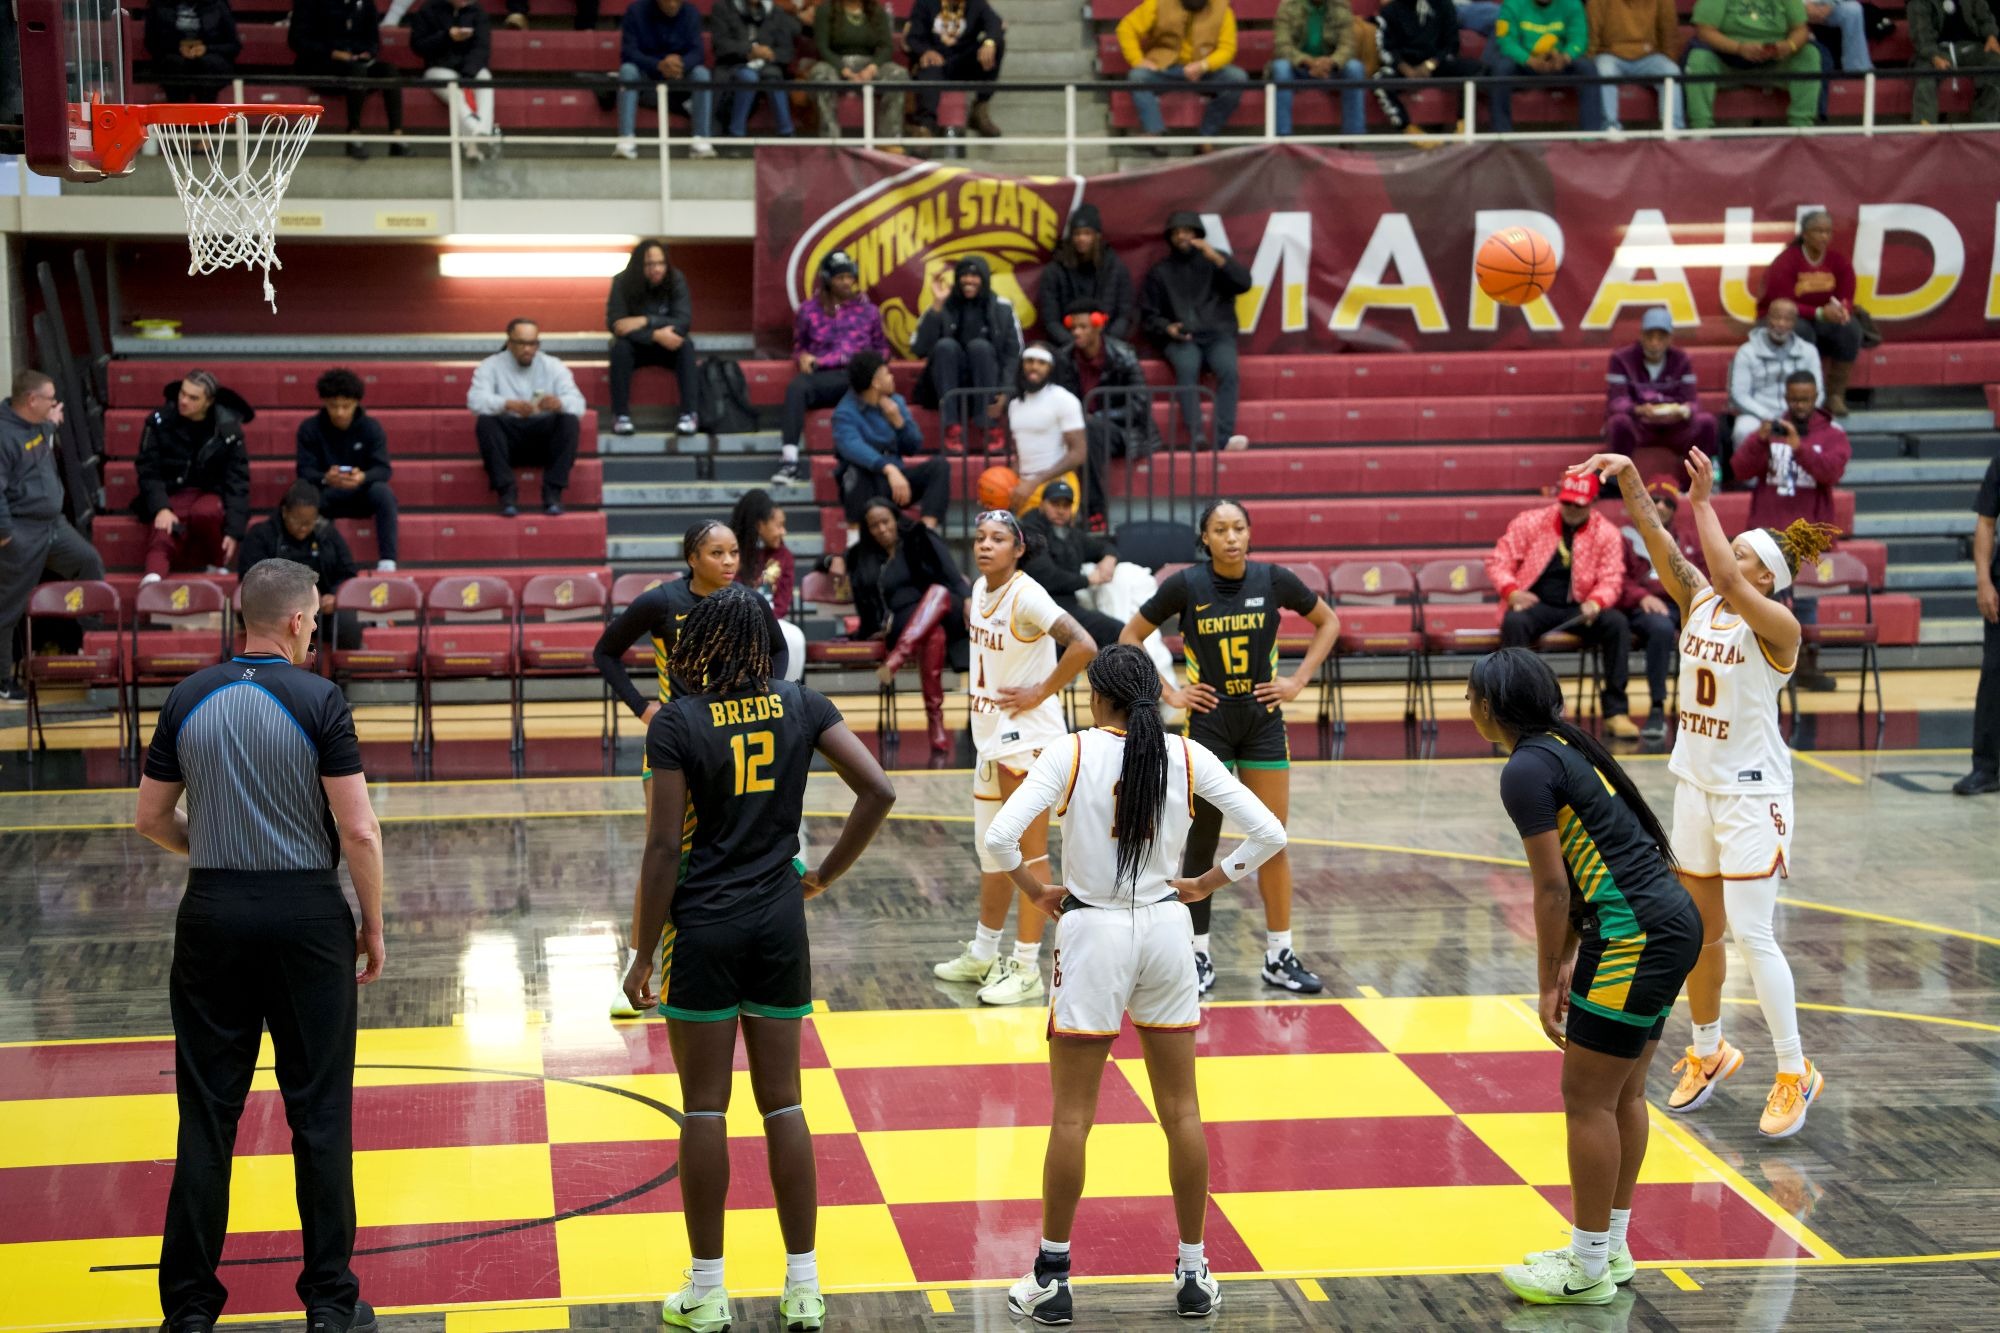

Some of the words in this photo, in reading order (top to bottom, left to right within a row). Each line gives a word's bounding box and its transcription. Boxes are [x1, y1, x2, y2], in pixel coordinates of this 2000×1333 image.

[958, 177, 1059, 252] STATE
[1200, 200, 2000, 334] MARAUD
[1197, 612, 1266, 635] KENTUCKY
[1218, 635, 1249, 675] 15
[1683, 632, 1745, 664] ENTRAL
[977, 653, 986, 690] 1
[1696, 666, 1717, 707] 0
[708, 693, 785, 728] BREDS
[1680, 710, 1730, 740] STATE
[729, 729, 776, 796] 12
